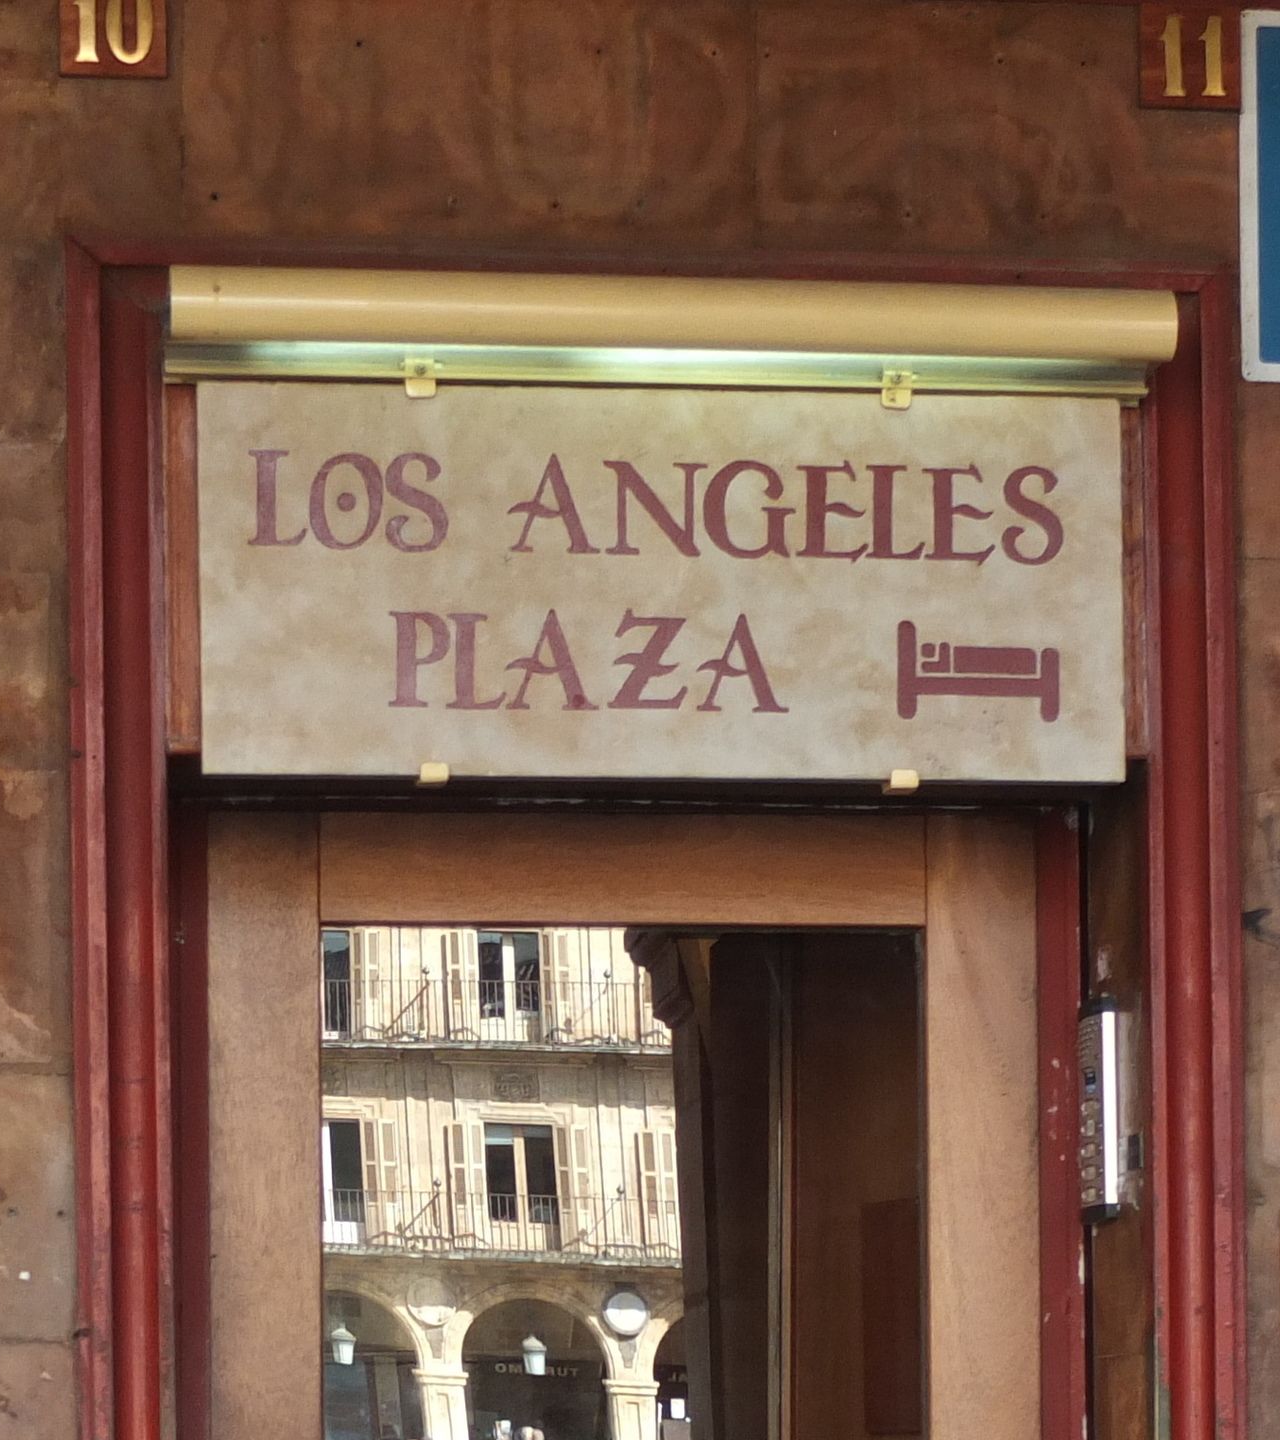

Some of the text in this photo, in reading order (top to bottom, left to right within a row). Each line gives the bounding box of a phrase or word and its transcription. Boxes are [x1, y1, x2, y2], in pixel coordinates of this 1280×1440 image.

[71, 0, 154, 64] 10
[1159, 14, 1227, 97] 11
[246, 448, 1065, 566] LOS ANGELES
[387, 608, 789, 714] PLAZA
